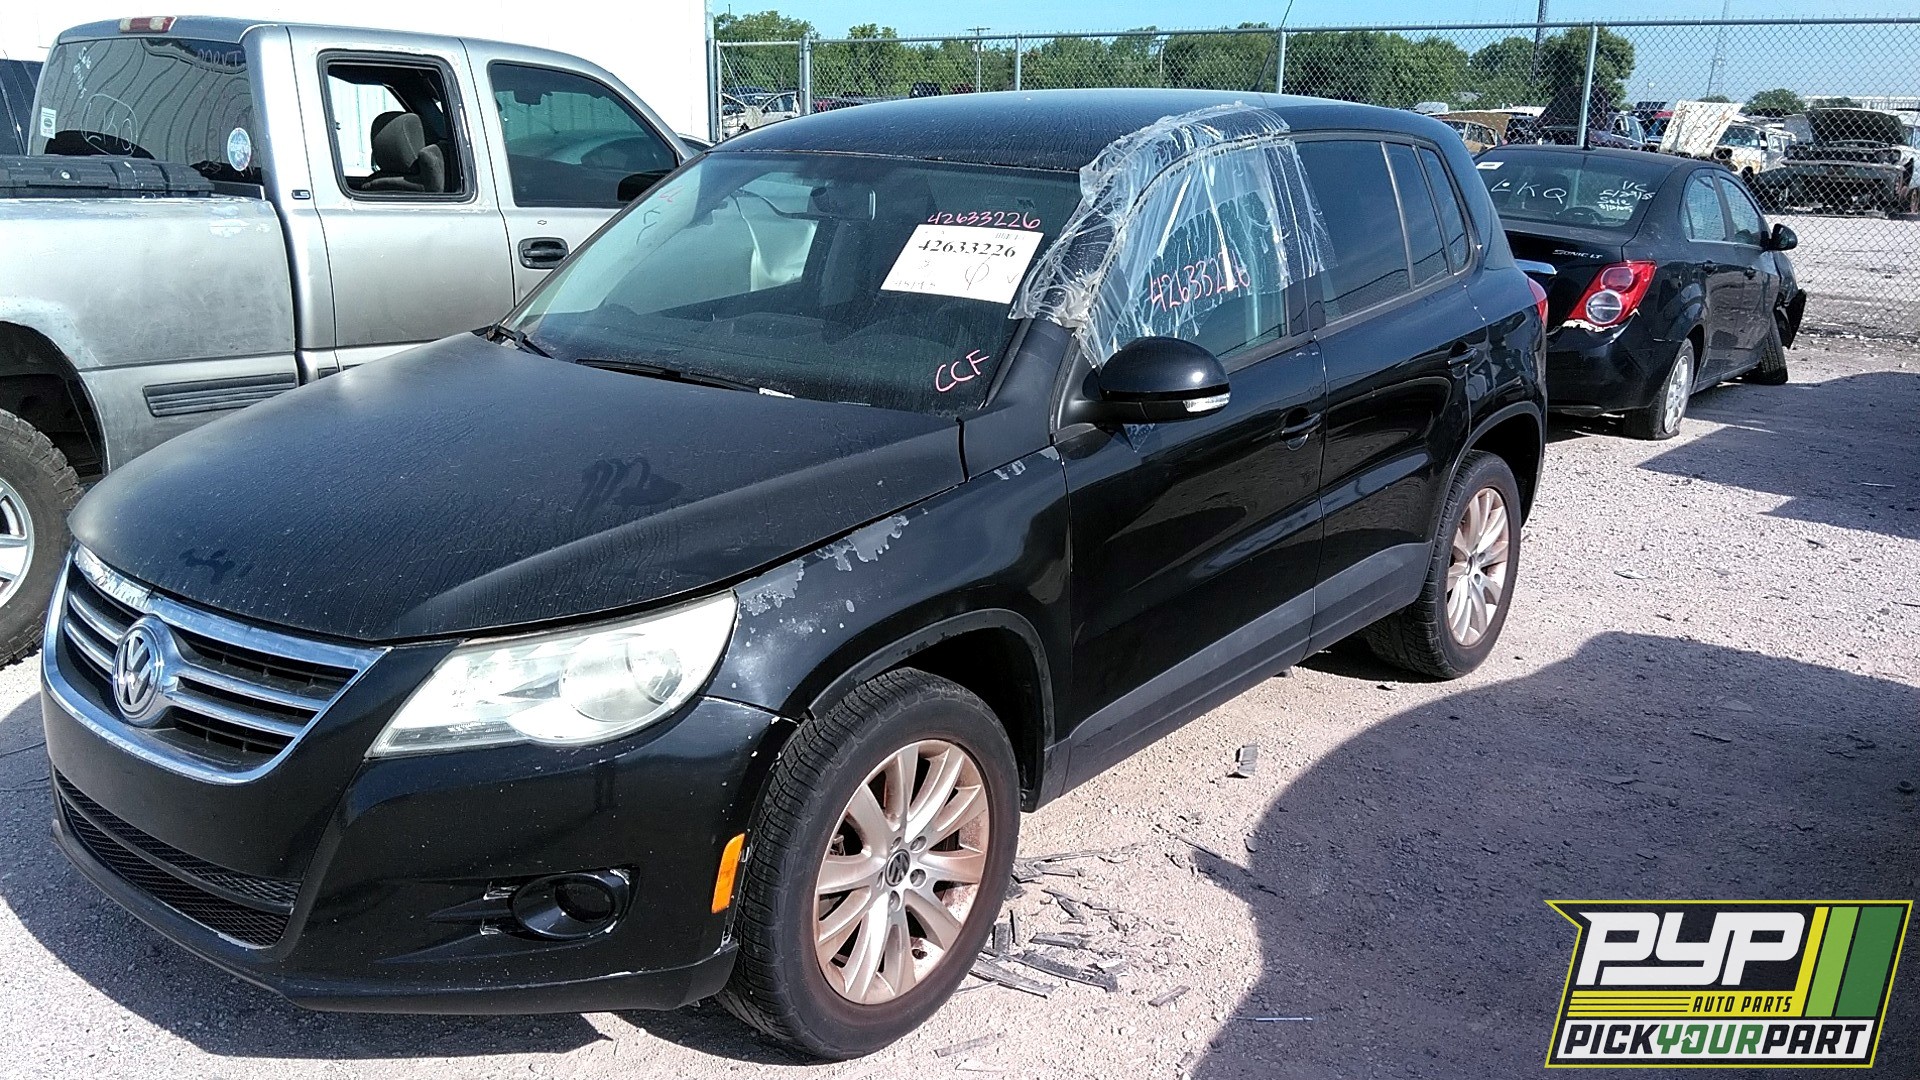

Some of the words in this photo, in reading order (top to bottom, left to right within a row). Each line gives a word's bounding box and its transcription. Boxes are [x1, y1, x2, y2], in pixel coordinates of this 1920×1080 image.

[1490, 177, 1567, 205] LKQ
[927, 211, 1041, 229] 42633226
[918, 239, 1016, 258] 42633226
[935, 348, 990, 392] CCF
